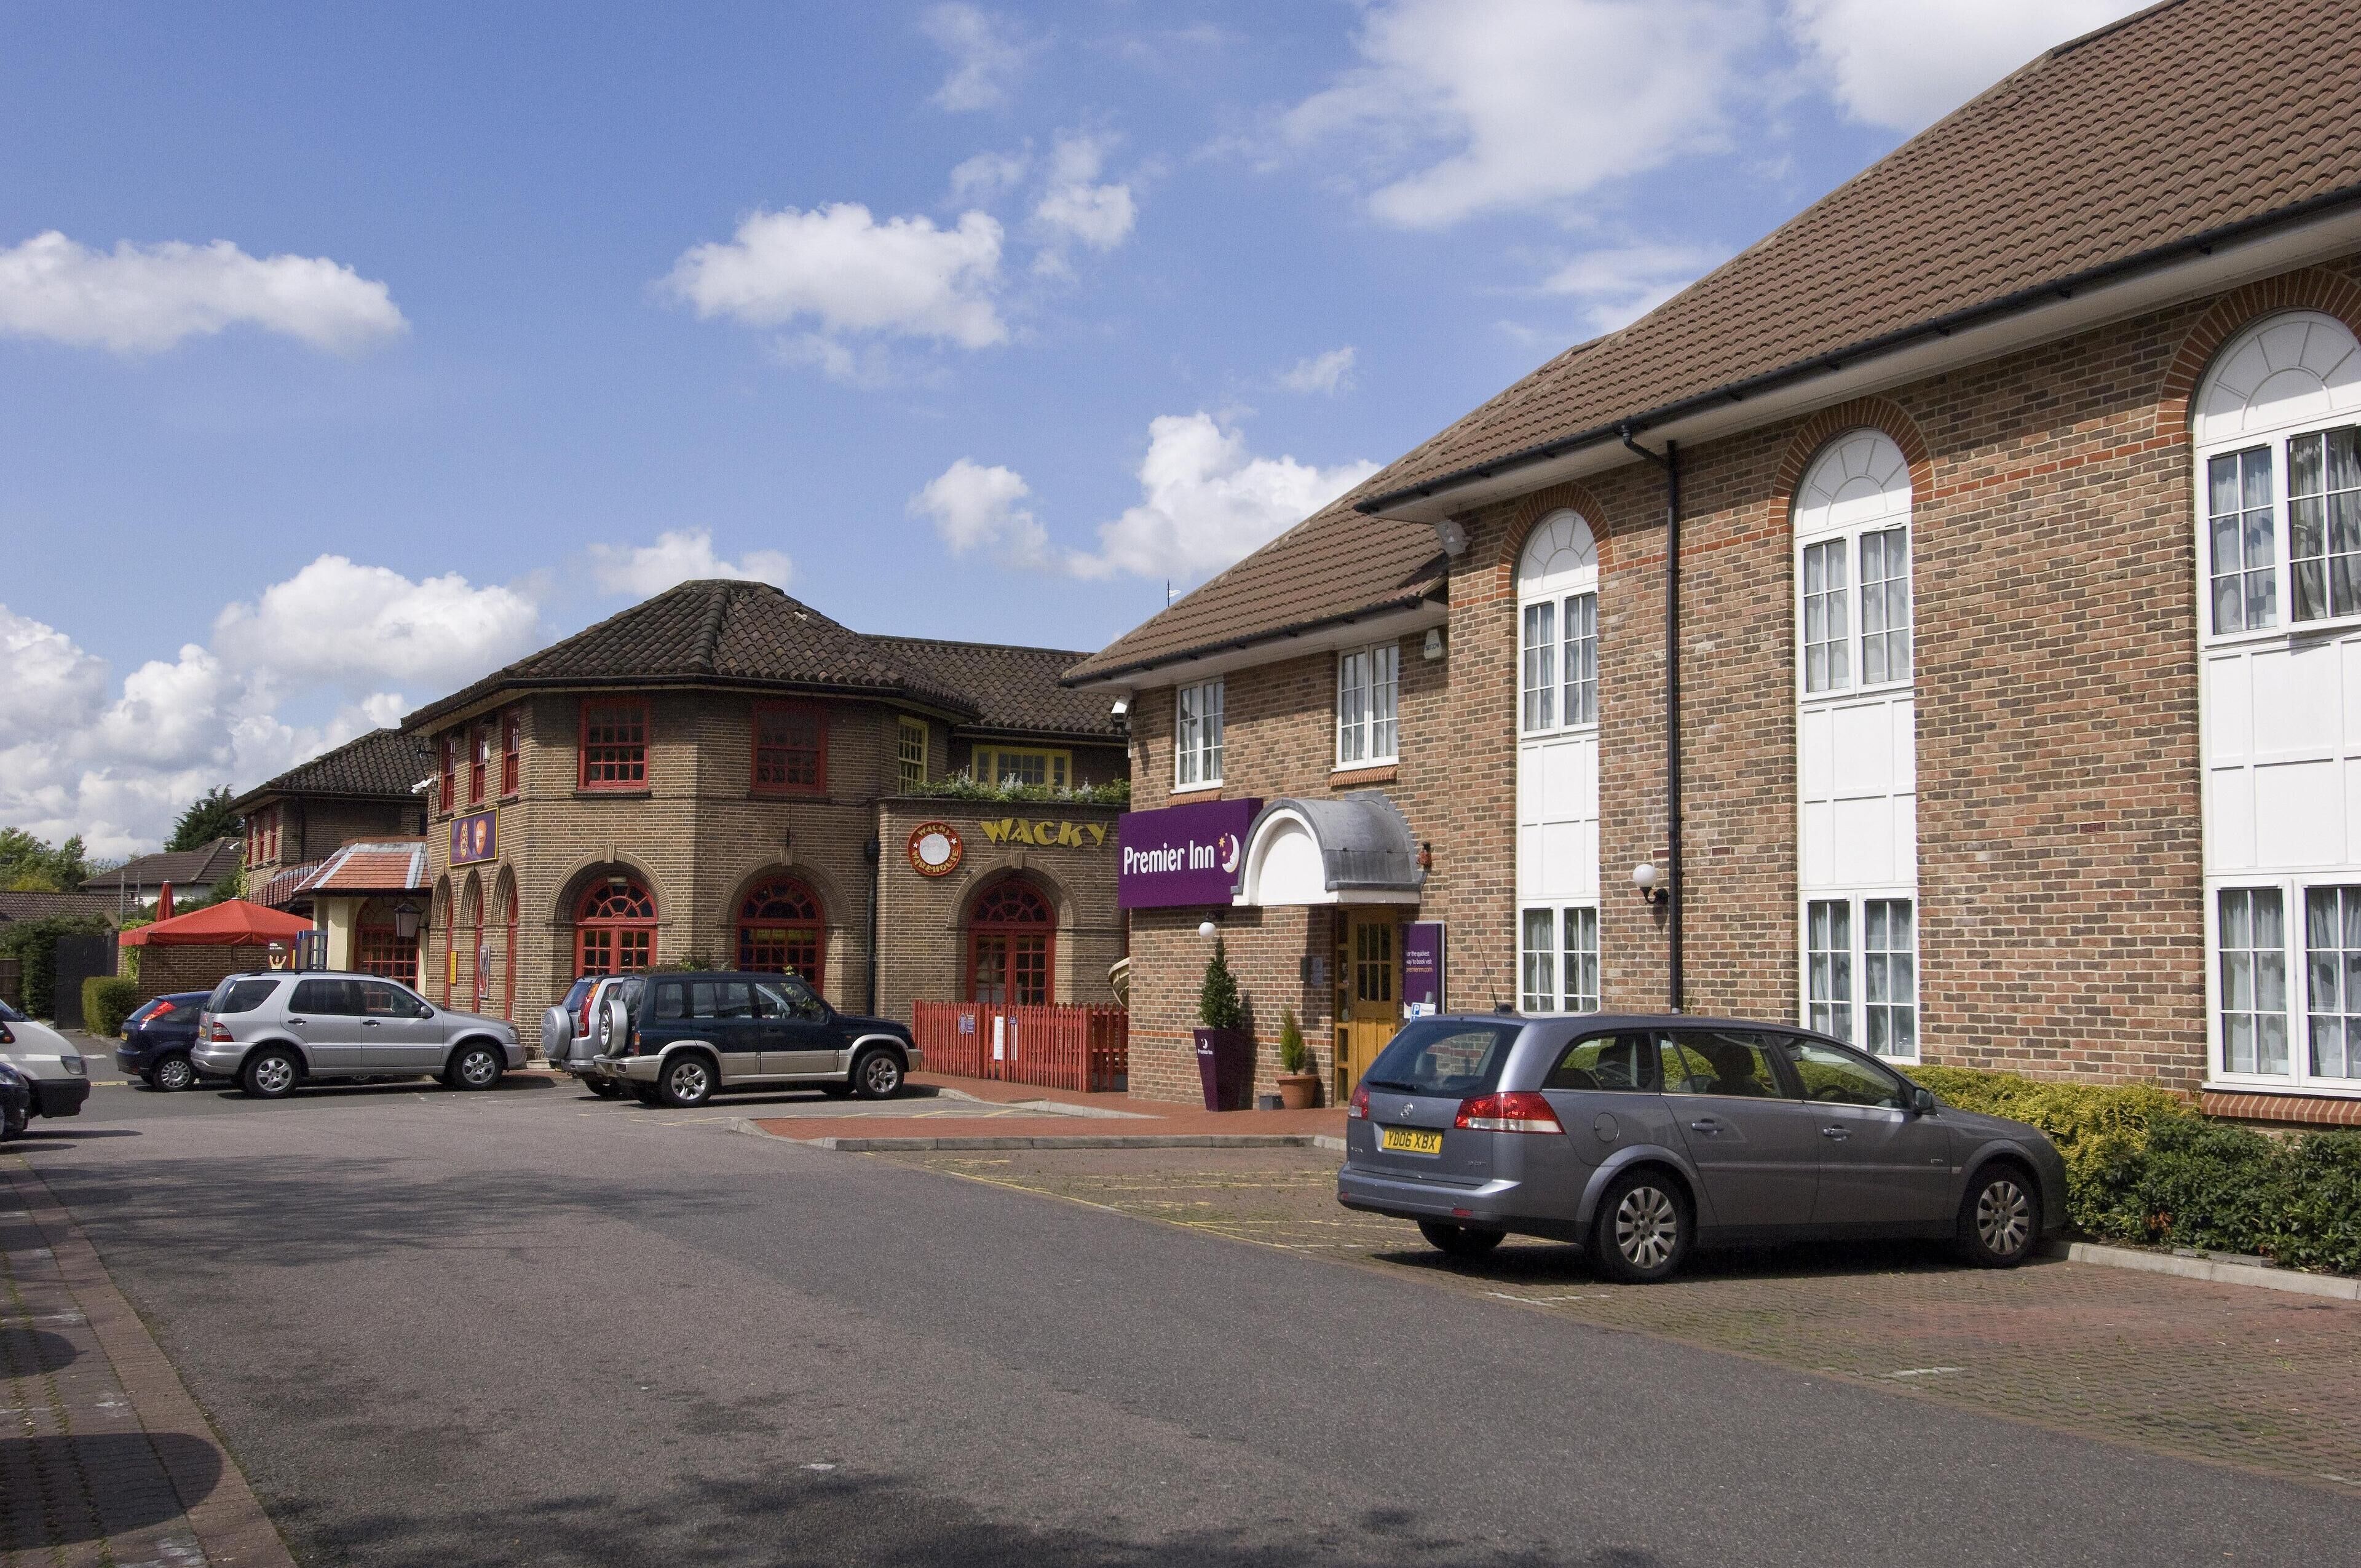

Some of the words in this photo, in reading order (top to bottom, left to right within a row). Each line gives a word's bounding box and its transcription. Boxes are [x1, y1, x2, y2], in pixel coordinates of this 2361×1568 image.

[917, 825, 951, 836] WACKY
[980, 818, 1108, 848] WACKY
[912, 850, 959, 873] WAREHOUSE
[1124, 842, 1185, 875] Premier
[1189, 840, 1214, 869] Inn
[1388, 1130, 1413, 1147] YD06
[1414, 1132, 1436, 1150] XBX
